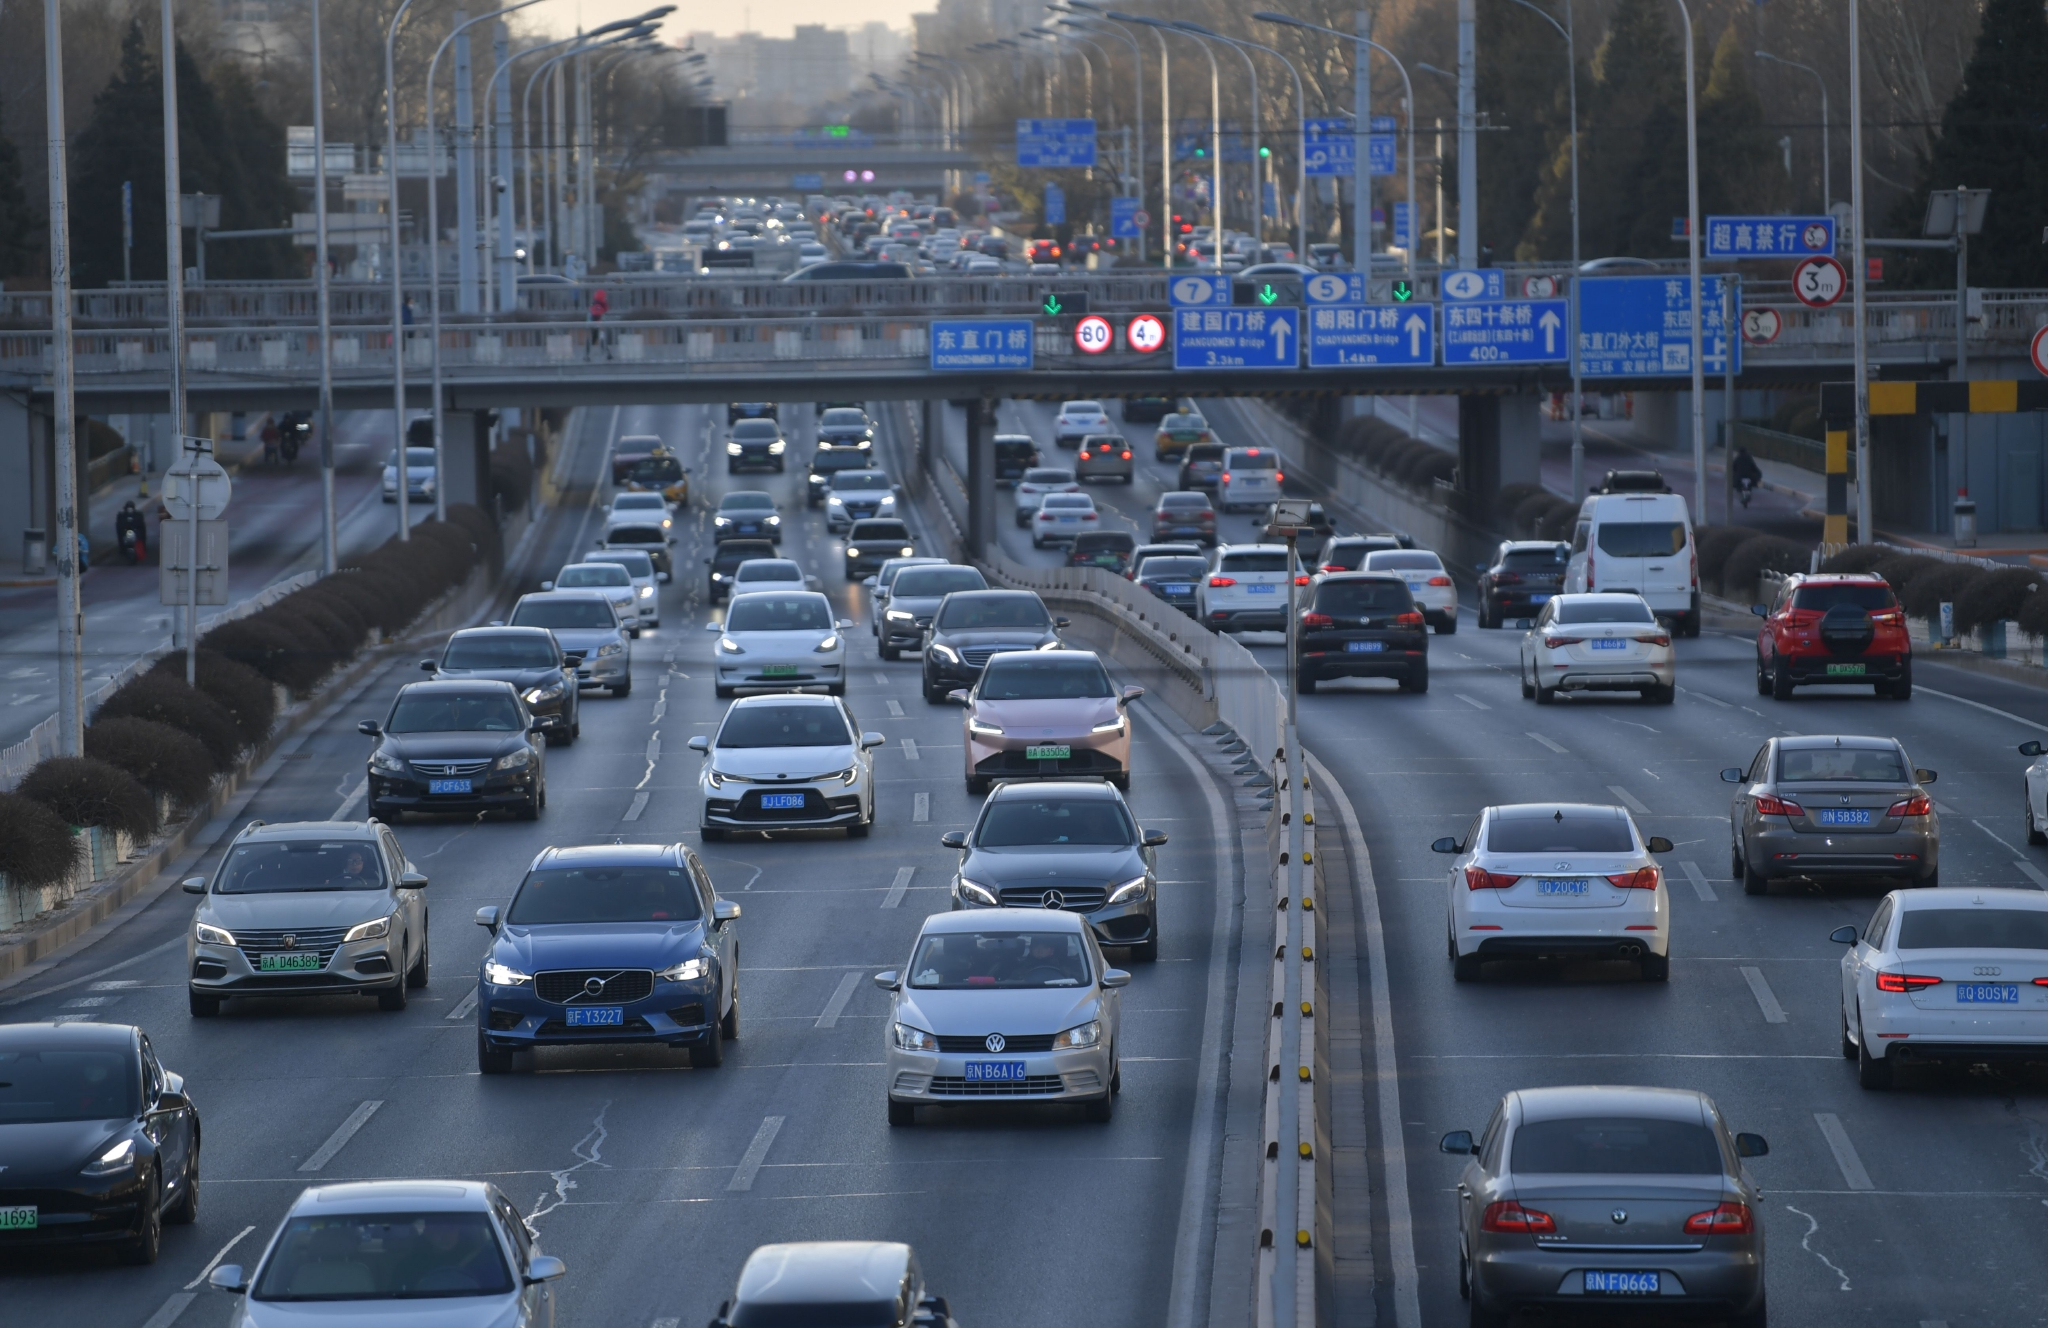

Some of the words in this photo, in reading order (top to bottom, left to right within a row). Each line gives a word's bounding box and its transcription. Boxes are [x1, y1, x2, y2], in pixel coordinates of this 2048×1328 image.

[1713, 223, 1797, 250] 超高禁行
[1186, 283, 1199, 299] 7
[1320, 280, 1335, 298] 5
[1455, 276, 1470, 294] 4
[1182, 311, 1266, 331] 建国门桥
[1315, 308, 1399, 330] 朝阳门桥
[1449, 305, 1533, 327] 东四十条桥
[937, 329, 1027, 349] 东直门桥
[1083, 325, 1106, 342] 80
[1182, 336, 1236, 347] JIANGUOMEN
[1239, 336, 1266, 348] Bridge
[1316, 334, 1372, 345] CHAOYANGMEN
[1374, 333, 1399, 346] Bridge
[998, 353, 1028, 365] Bridge
[1206, 351, 1244, 366] 3.3km
[1338, 349, 1378, 363] 1.4km
